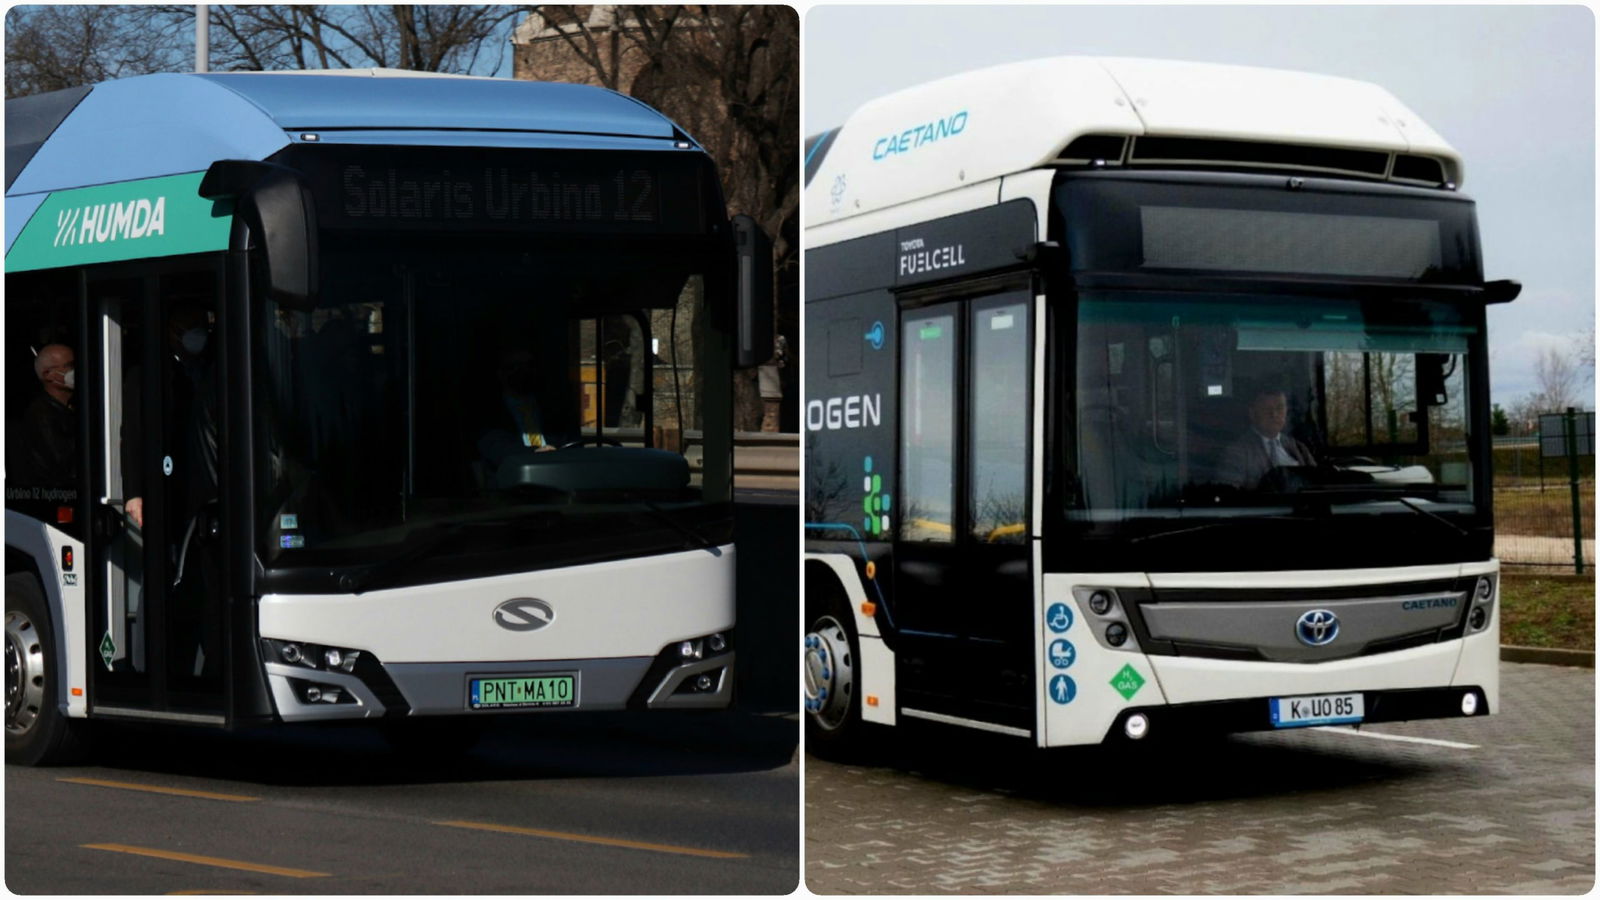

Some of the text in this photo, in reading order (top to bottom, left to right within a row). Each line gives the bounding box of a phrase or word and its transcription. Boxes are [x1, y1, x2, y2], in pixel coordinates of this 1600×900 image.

[873, 111, 968, 160] CAETANO
[343, 164, 657, 221] Solaris Urbino 12
[79, 196, 166, 245] HUMDA
[900, 245, 965, 276] FUELCELL
[807, 393, 881, 431] OGEN
[1402, 597, 1457, 610] CAETANO
[484, 679, 568, 702] PNT MA10
[1117, 681, 1137, 690] GAS
[1291, 700, 1302, 719] K
[1335, 697, 1353, 716] 85
